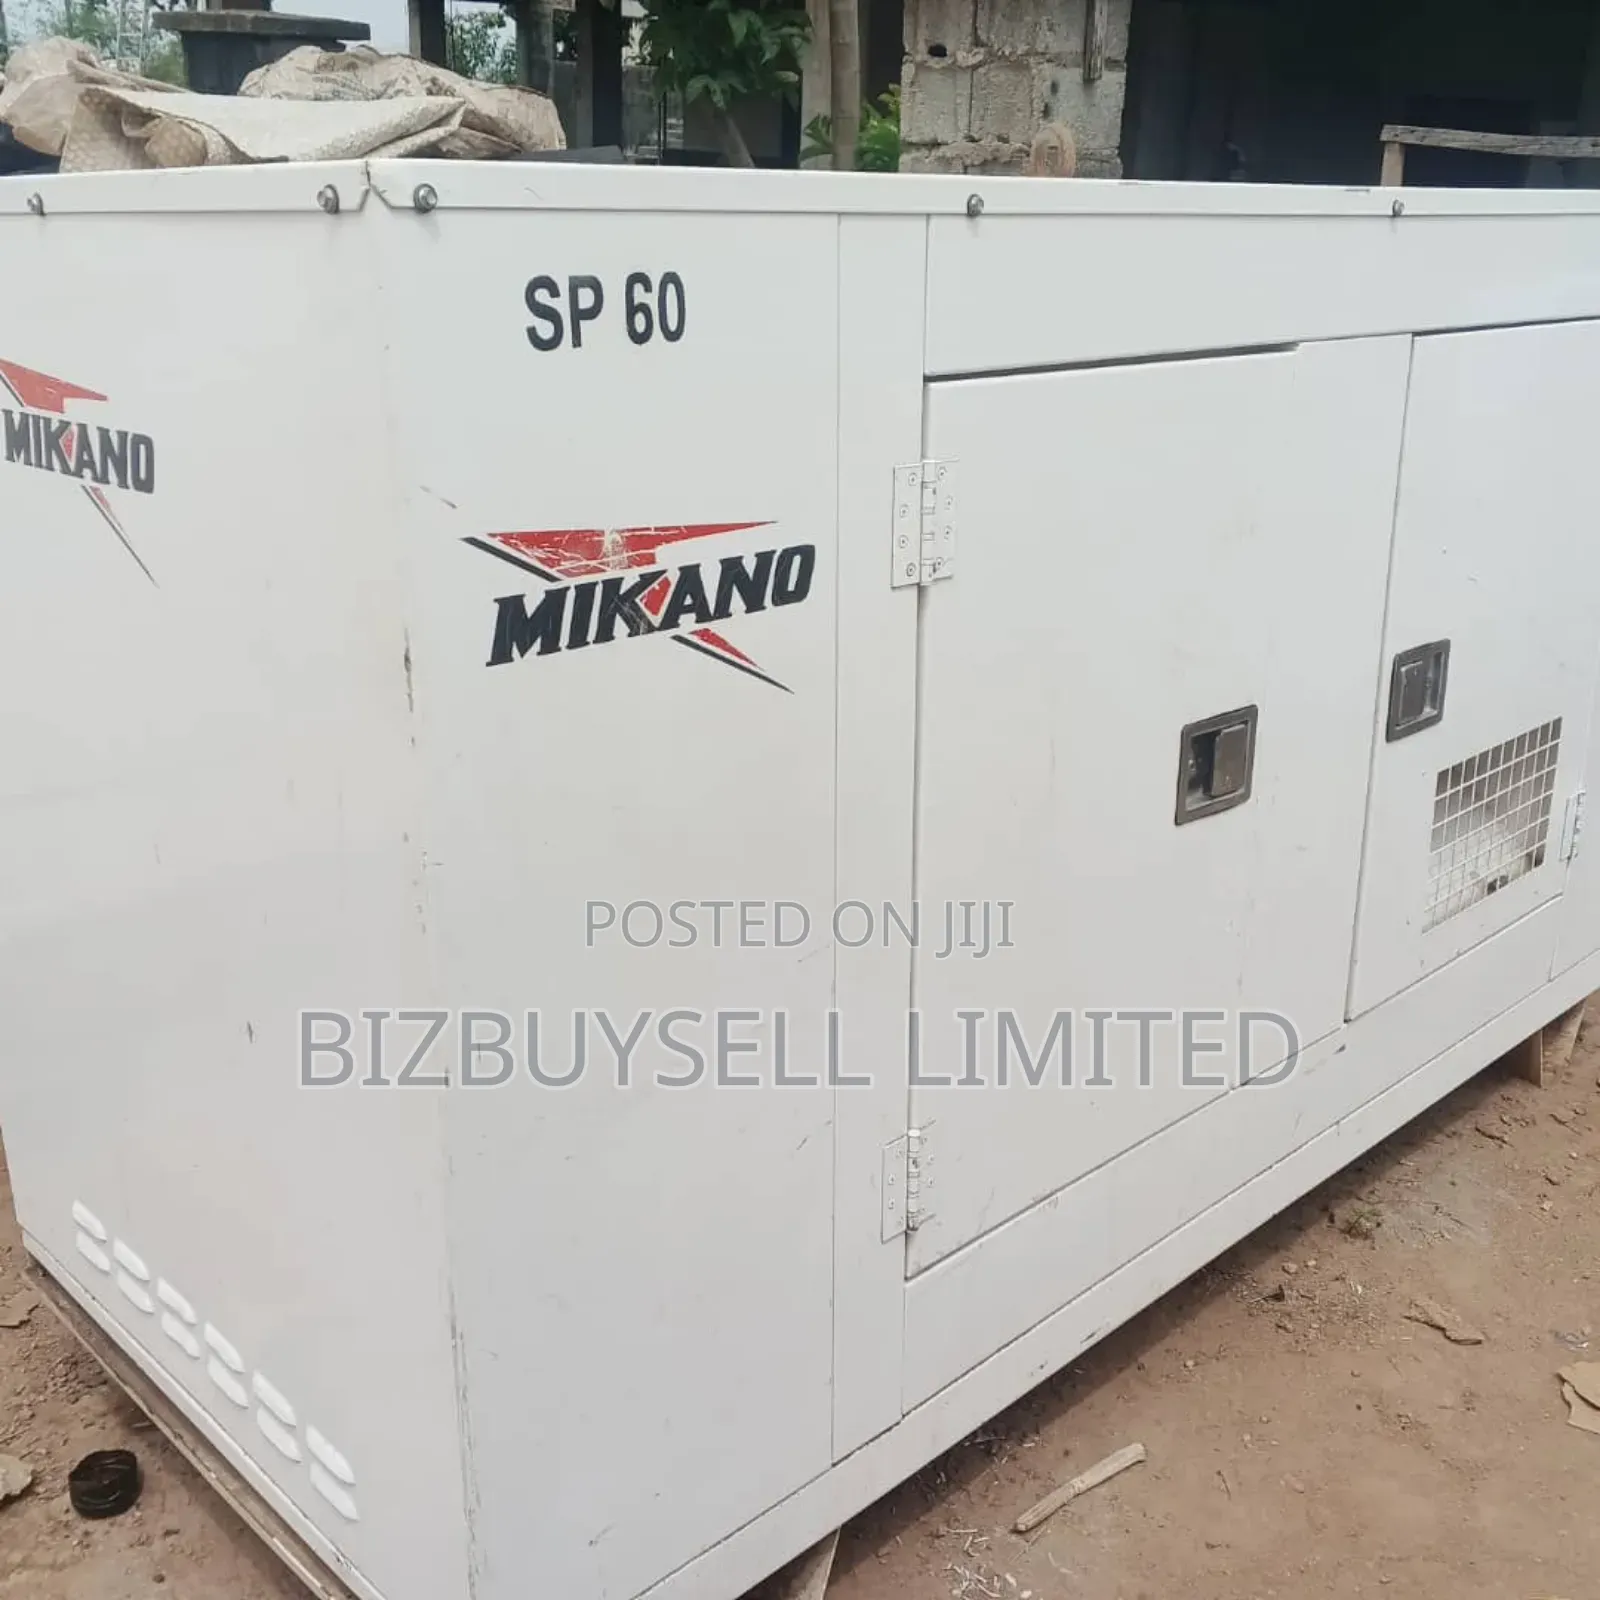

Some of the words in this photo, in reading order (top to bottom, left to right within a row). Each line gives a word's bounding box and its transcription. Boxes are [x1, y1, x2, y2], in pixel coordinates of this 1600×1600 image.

[524, 274, 604, 351] SP
[625, 271, 687, 346] 60
[2, 408, 156, 495] MIKANO
[485, 543, 816, 667] MIKANO
